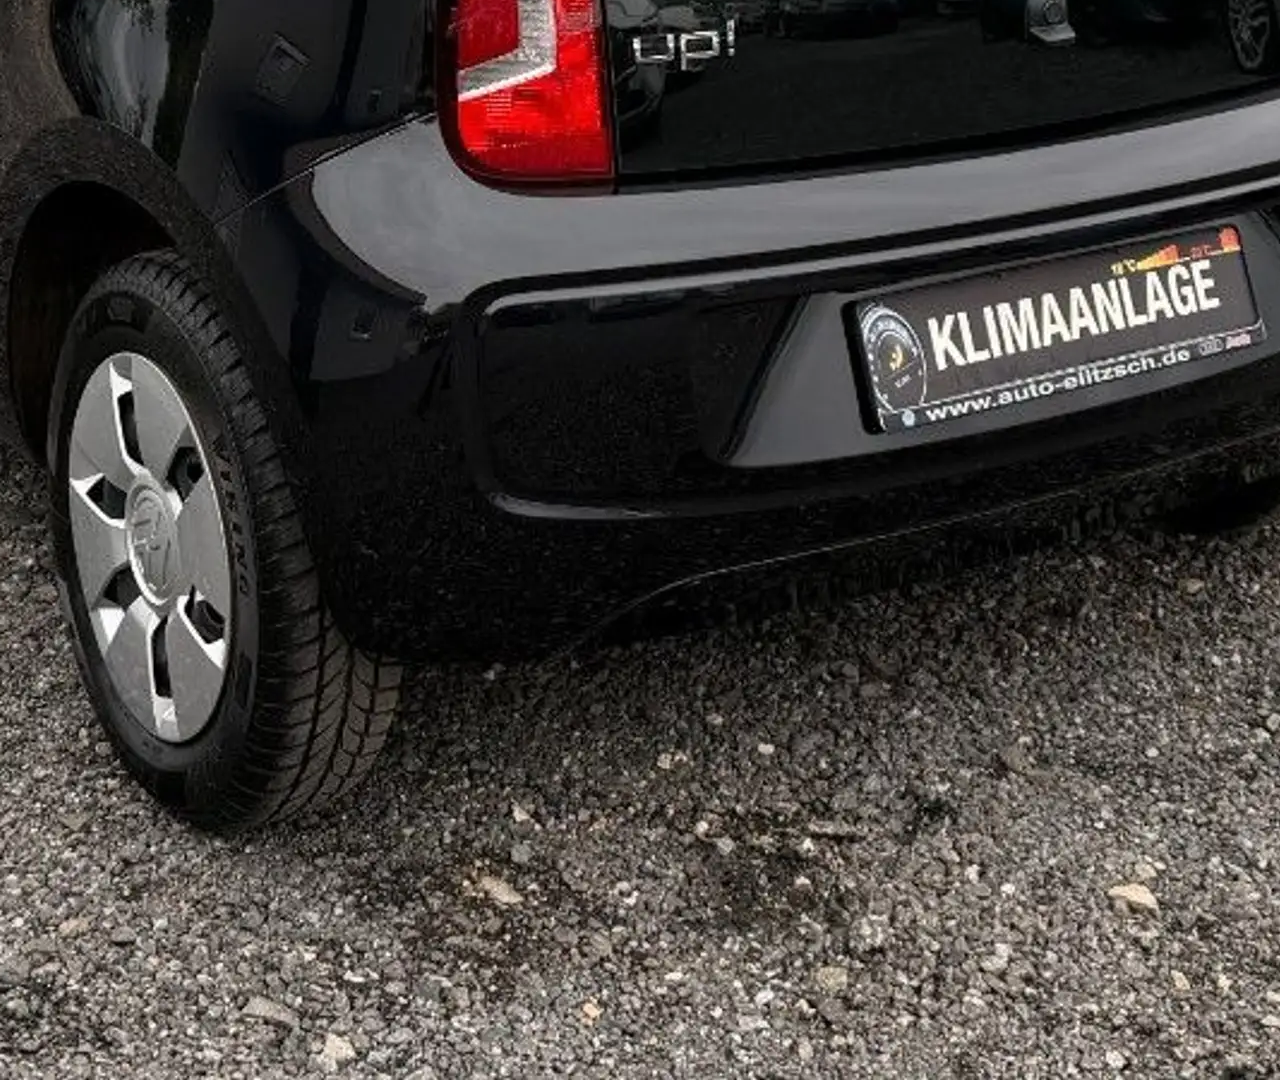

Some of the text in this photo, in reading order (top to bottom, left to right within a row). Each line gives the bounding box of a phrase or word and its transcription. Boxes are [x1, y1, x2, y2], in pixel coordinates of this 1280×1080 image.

[632, 19, 736, 71] up!
[927, 259, 1221, 371] KLIMAANLAGE
[926, 348, 1191, 421] www.auto-elitzsch.de
